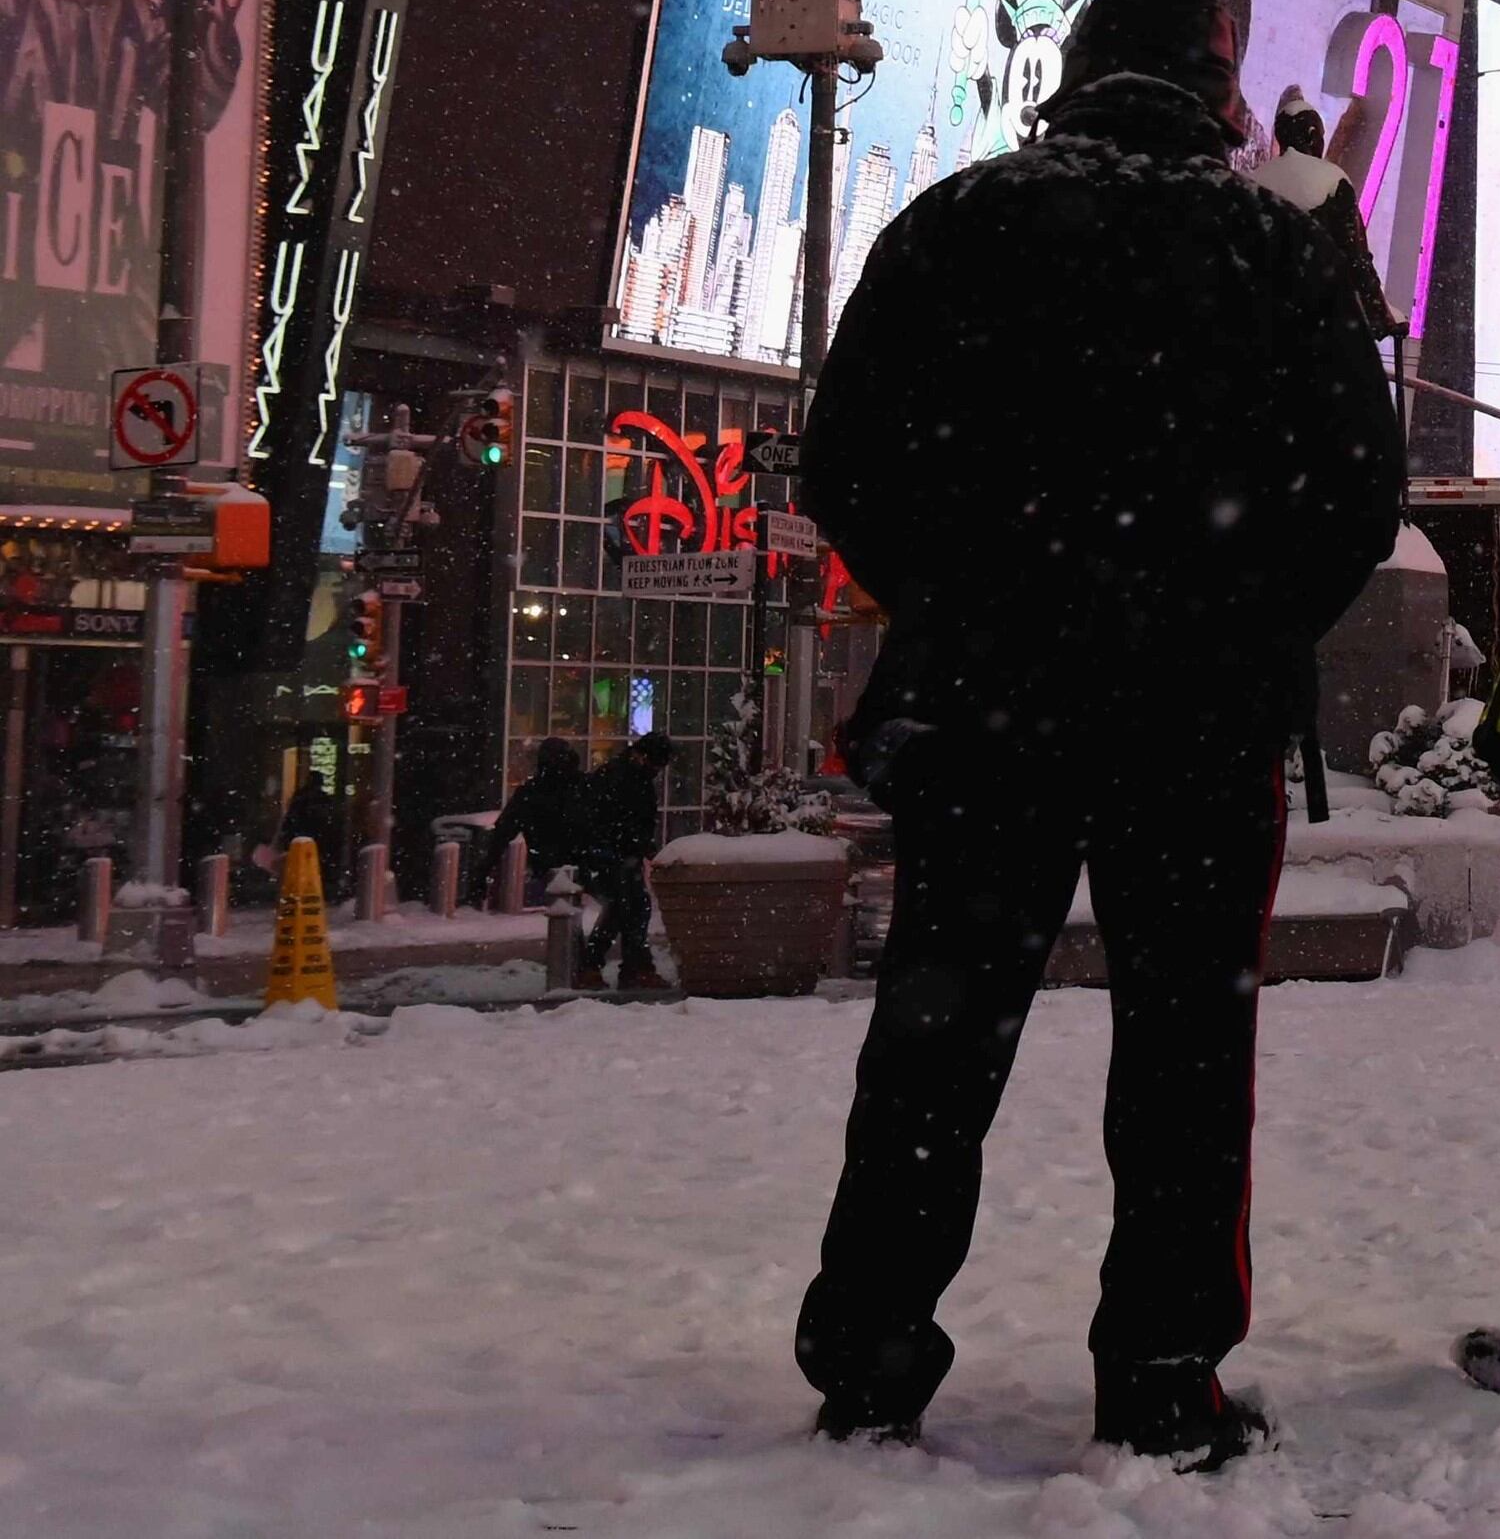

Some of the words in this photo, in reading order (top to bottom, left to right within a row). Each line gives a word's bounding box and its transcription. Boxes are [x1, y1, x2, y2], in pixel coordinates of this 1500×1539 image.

[761, 445, 794, 464] ONE
[628, 557, 685, 574] PEDESTRIAN
[687, 557, 711, 571] FLOW
[628, 577, 651, 590] KEEP
[653, 575, 689, 589] MOVING
[72, 613, 138, 634] SONY
